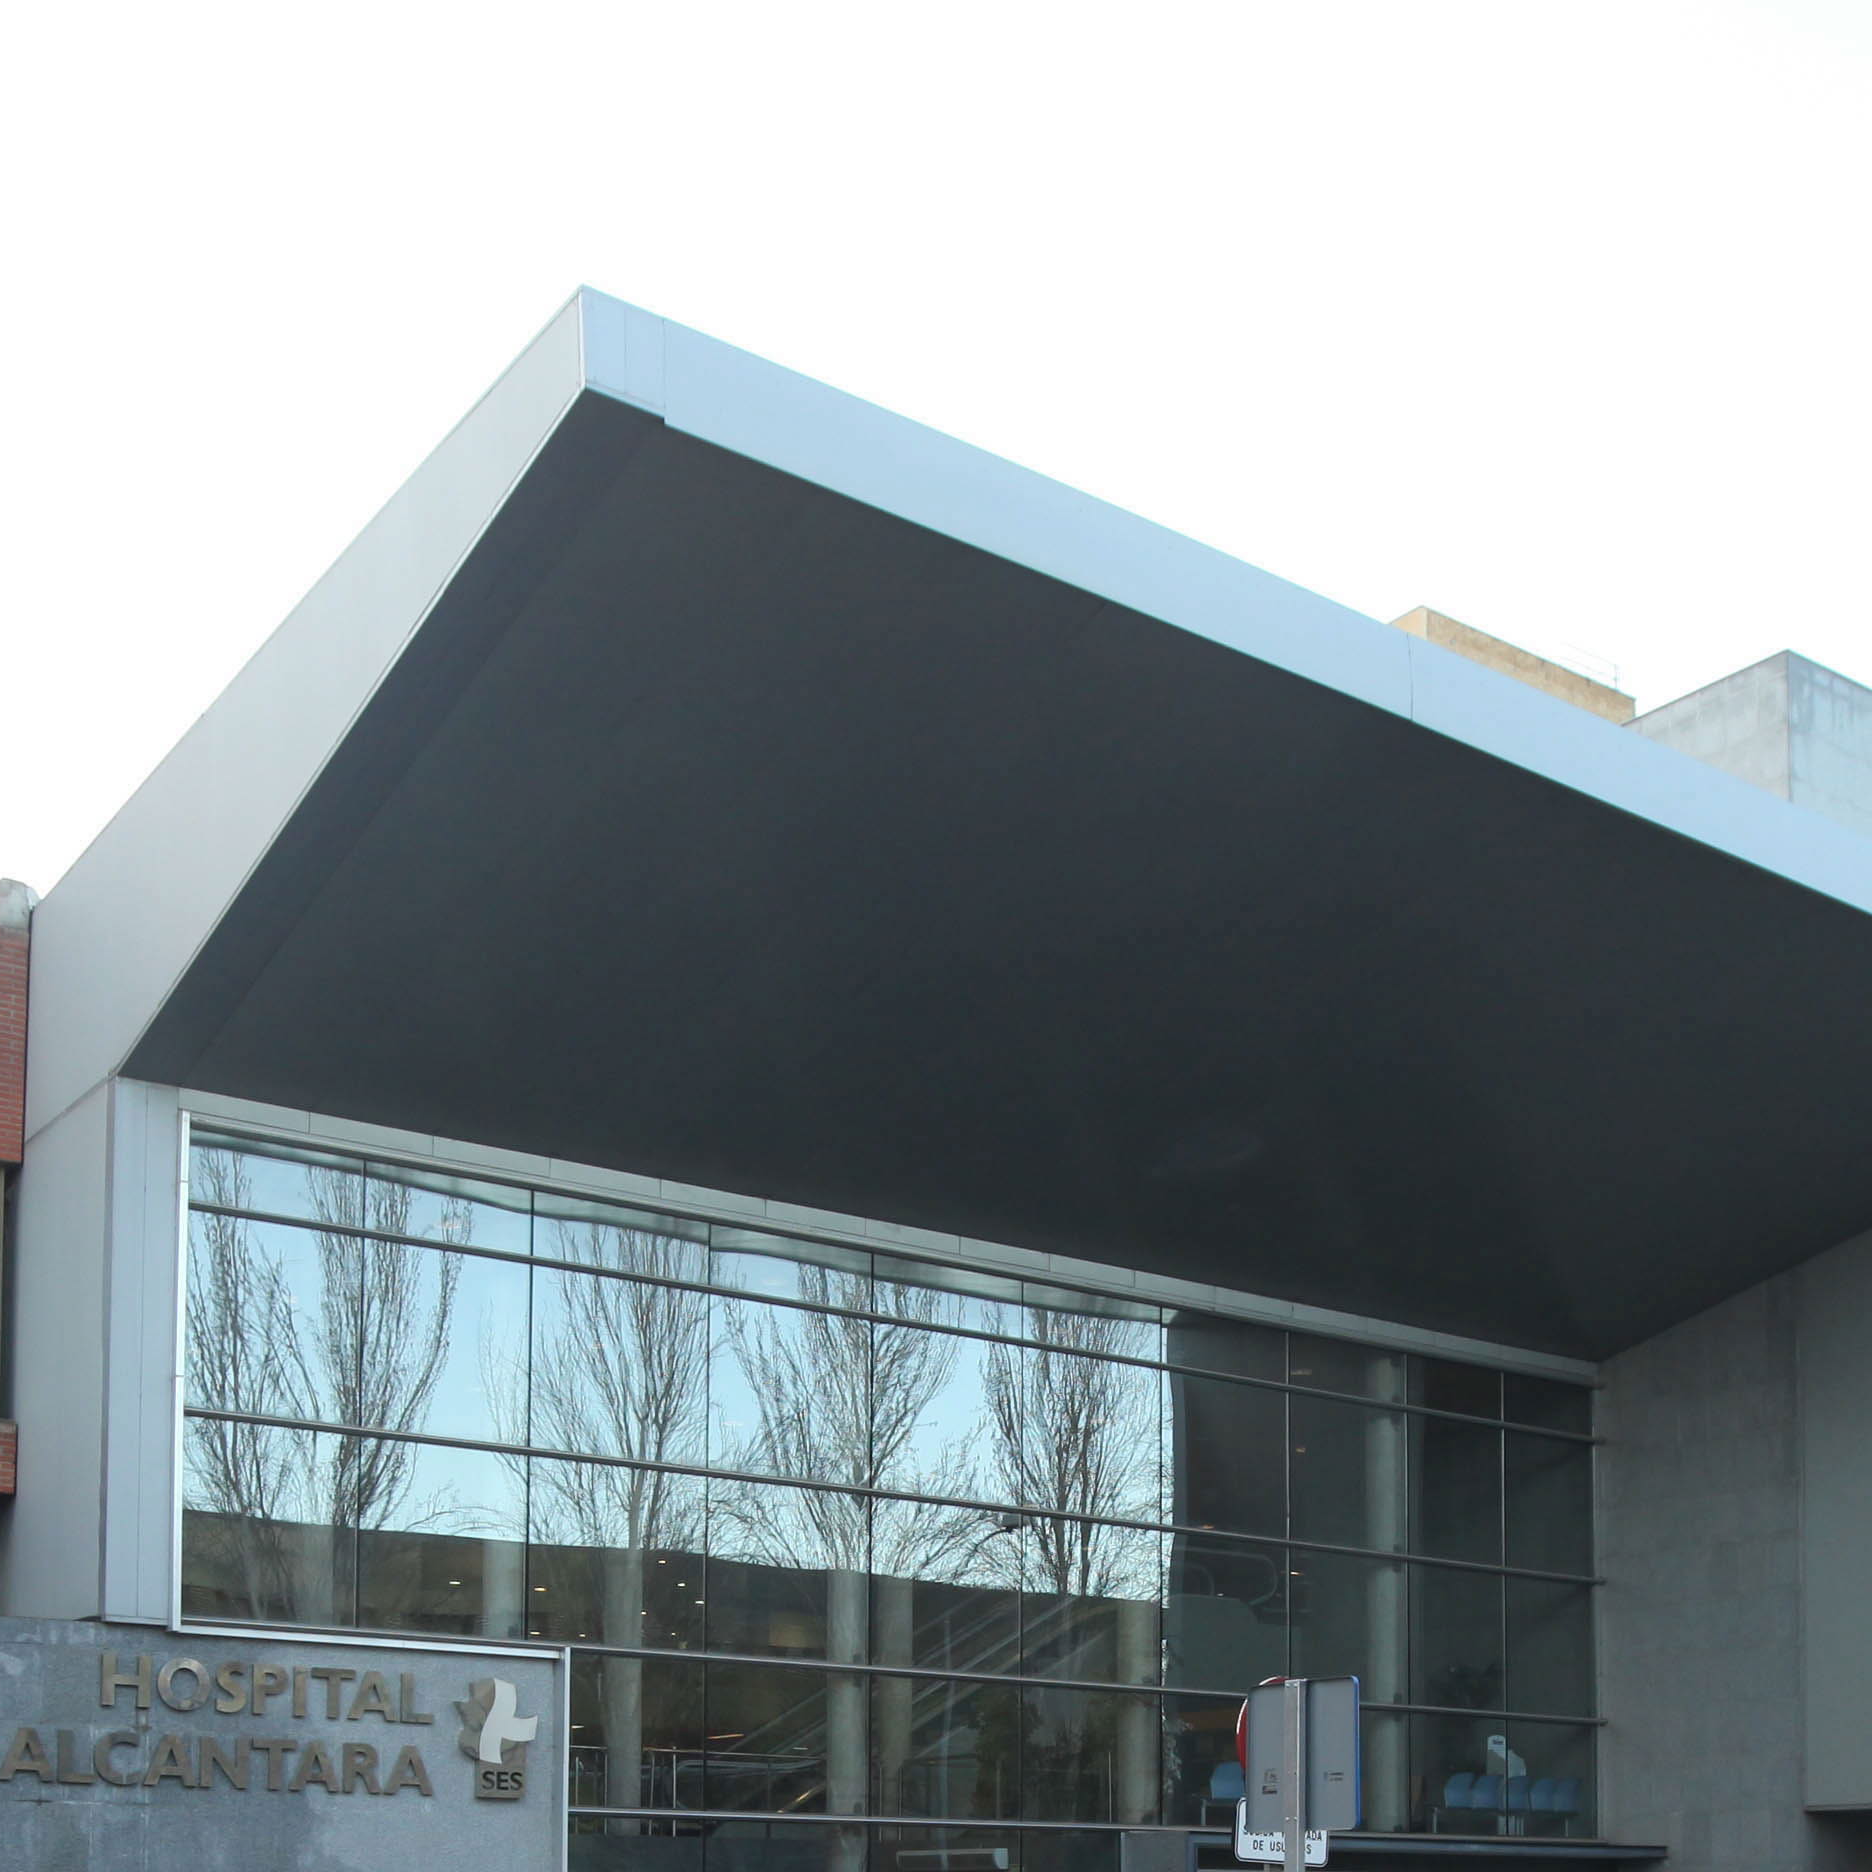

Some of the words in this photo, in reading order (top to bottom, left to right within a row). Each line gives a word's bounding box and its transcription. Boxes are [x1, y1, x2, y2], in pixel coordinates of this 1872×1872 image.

[100, 1653, 435, 1725] HOSPITAL
[482, 1770, 523, 1792] SES
[1253, 1840, 1264, 1851] DE
